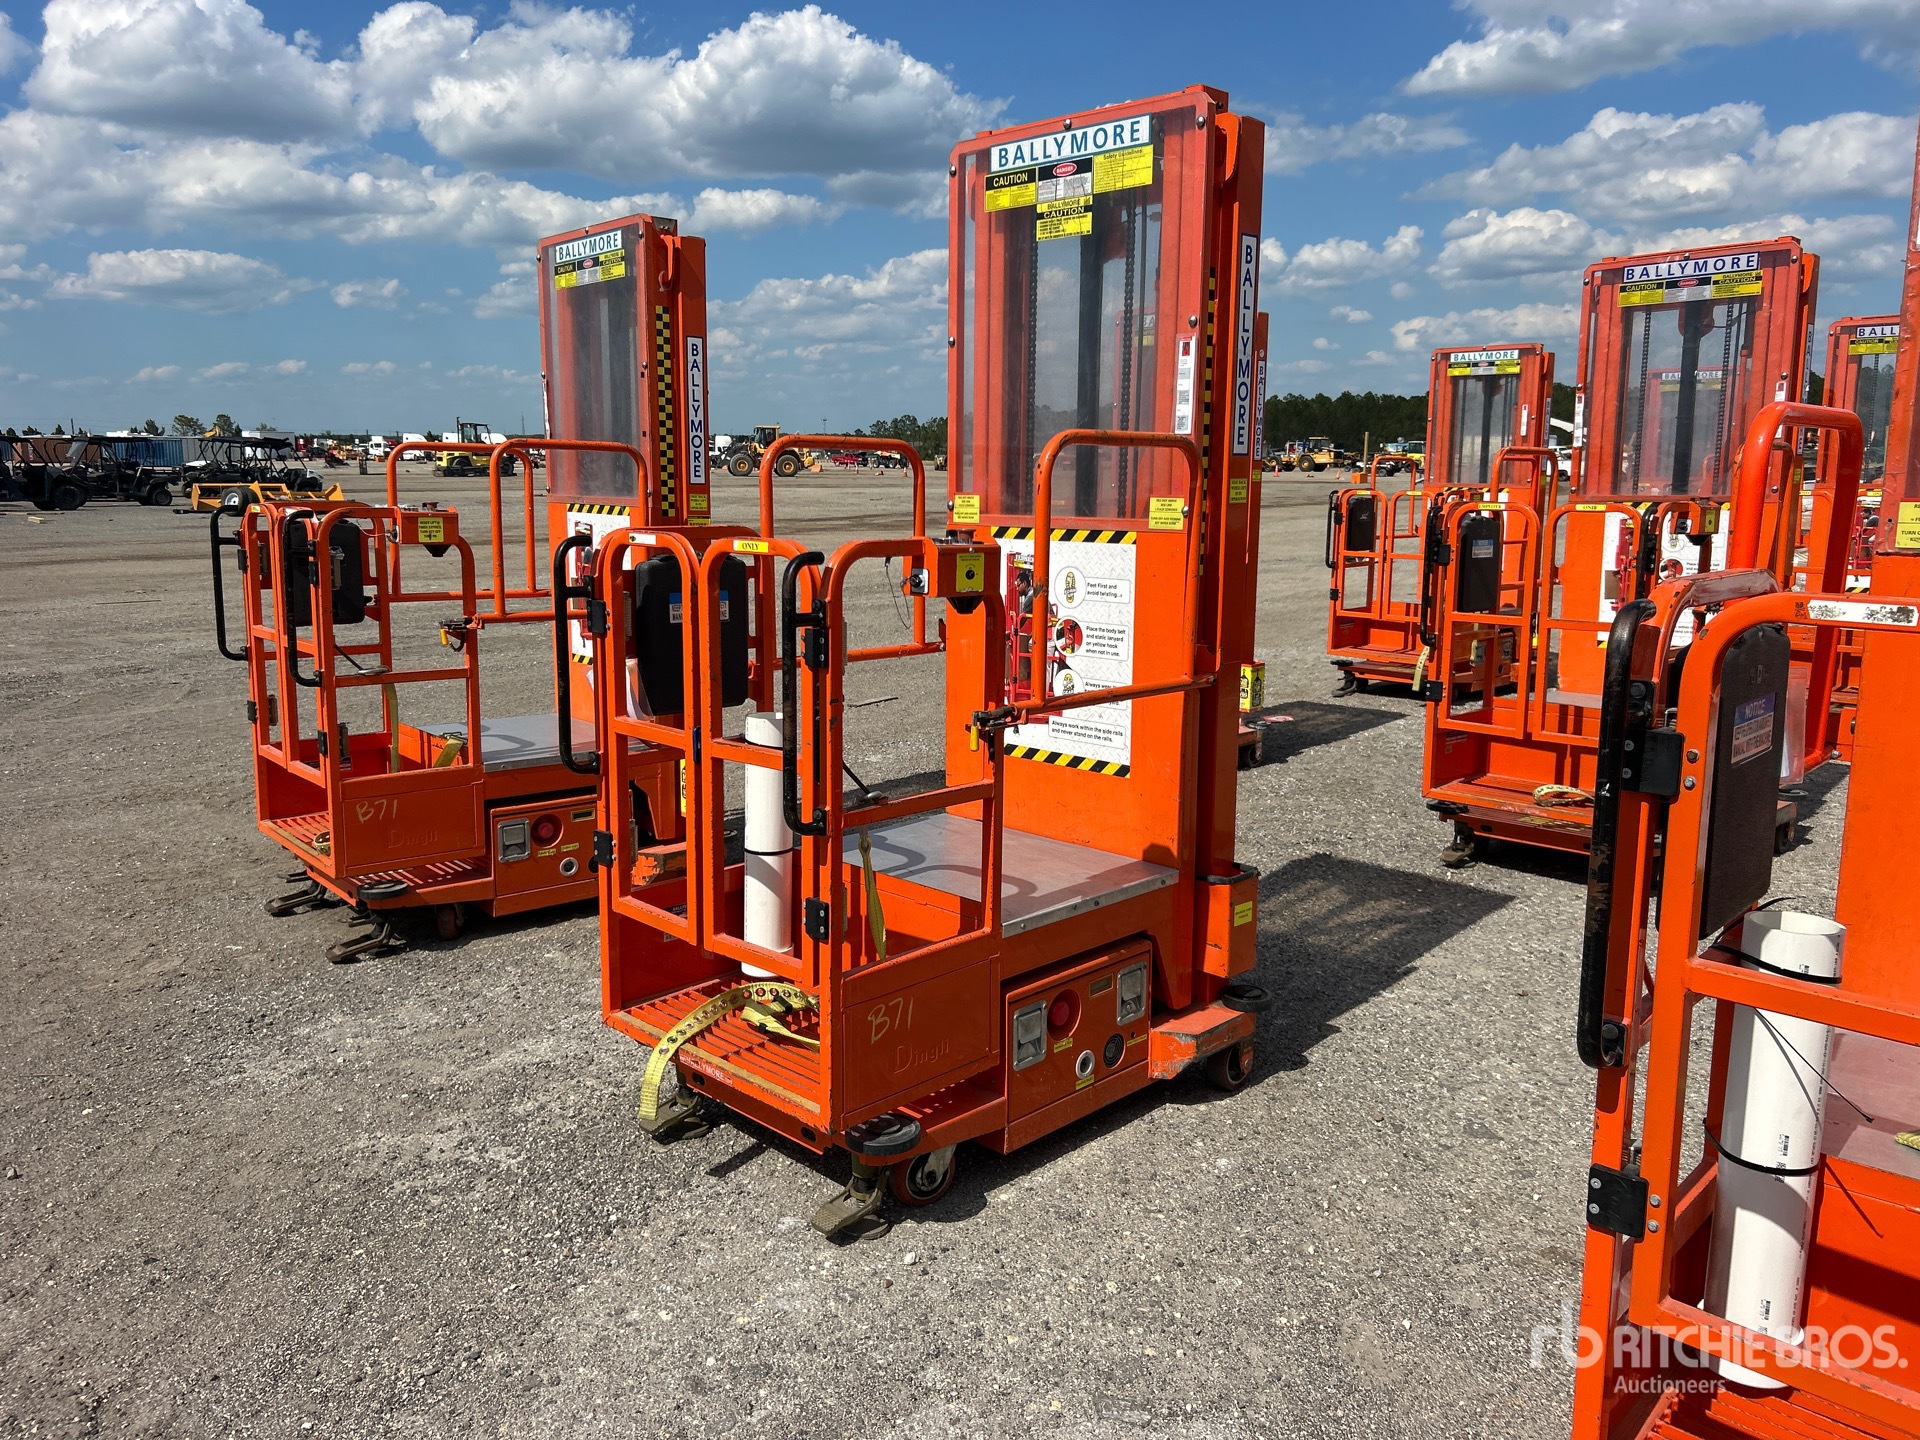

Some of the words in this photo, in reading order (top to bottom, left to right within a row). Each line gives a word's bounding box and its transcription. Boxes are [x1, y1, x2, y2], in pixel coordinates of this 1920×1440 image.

[999, 120, 1141, 168] BALLYMORE
[1103, 153, 1117, 161] Safety
[993, 172, 1028, 187] CAUTION
[1044, 206, 1085, 219] CAUTION
[1047, 198, 1081, 210] BALLYMORE
[559, 233, 618, 261] BALLYMORE
[557, 265, 573, 274] CAUTION
[1626, 255, 1756, 281] BALLYMORE
[1626, 284, 1657, 292] CAUTION
[1719, 277, 1756, 285] CAUTION
[1237, 245, 1253, 445] BALLYMORE
[1454, 351, 1515, 361] BALLYMORE
[690, 343, 703, 478] BALLYMORE
[1256, 366, 1264, 457] BALLYMORE
[1745, 699, 1765, 719] NOTICE
[1052, 720, 1067, 728] Always
[355, 799, 398, 824] B71
[387, 827, 439, 848] Dingli
[868, 995, 914, 1045] B71
[893, 1038, 949, 1074] Dingli
